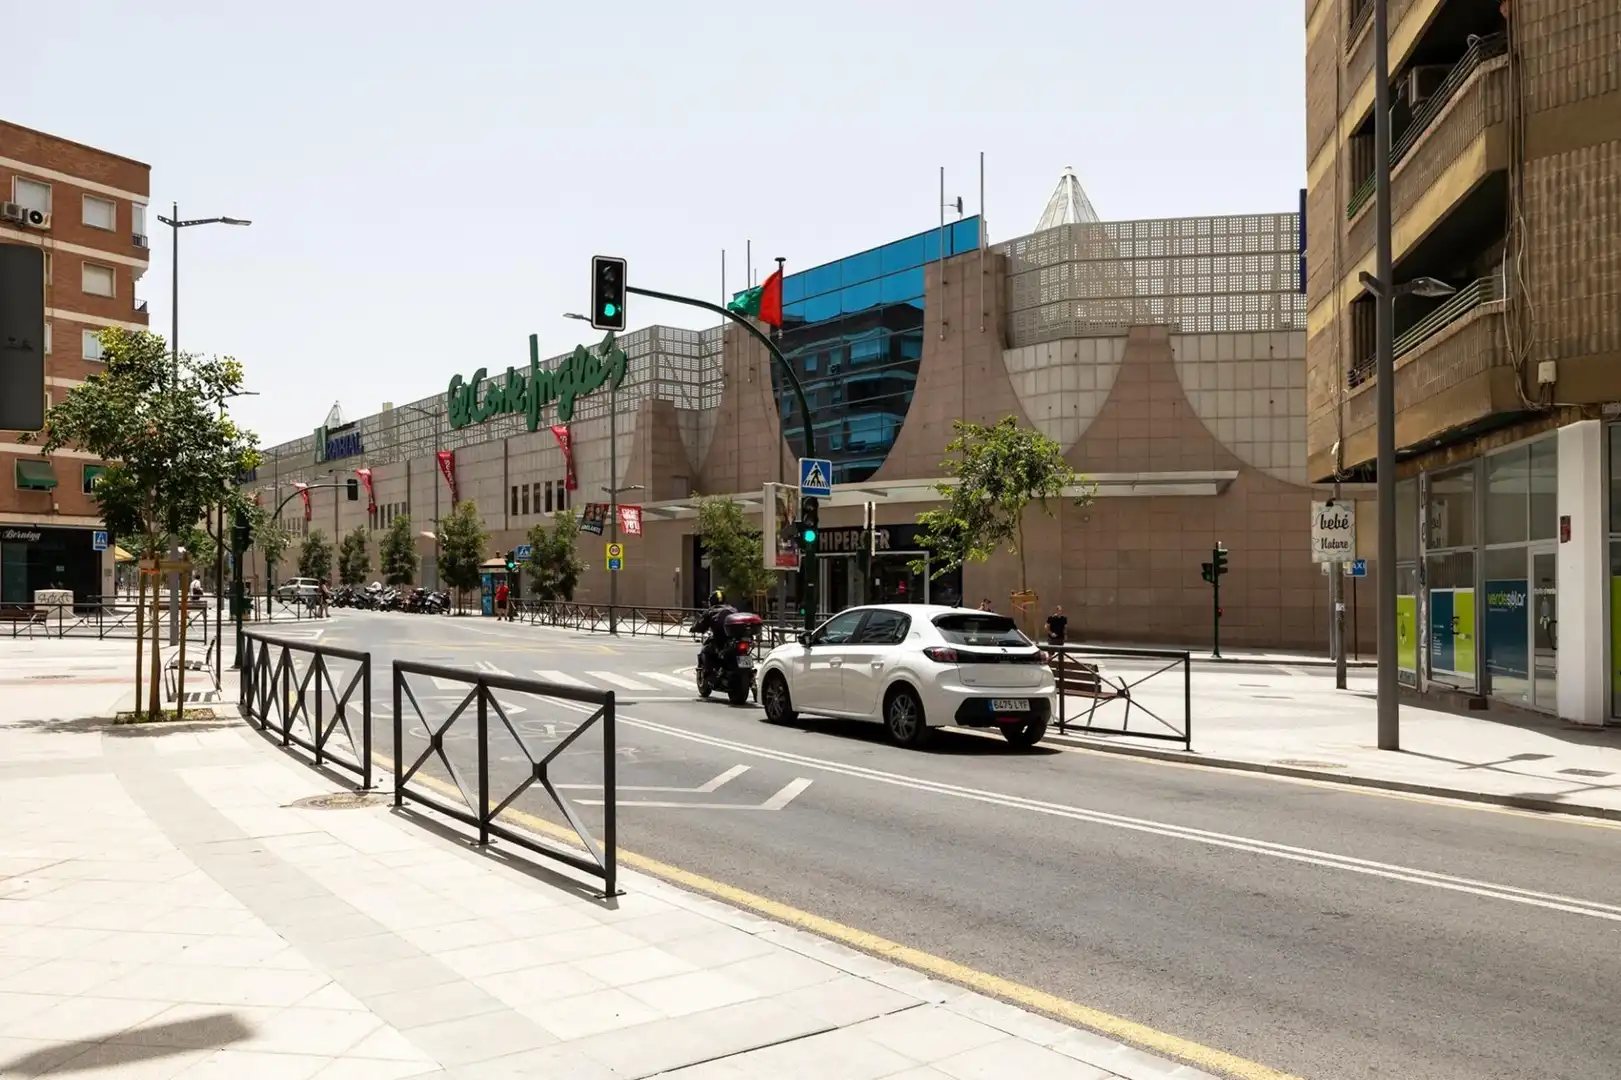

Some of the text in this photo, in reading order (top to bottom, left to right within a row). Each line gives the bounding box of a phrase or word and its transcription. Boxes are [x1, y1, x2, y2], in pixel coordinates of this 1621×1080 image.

[1320, 513, 1350, 530] bebé
[819, 529, 891, 551] HIPERCR
[994, 700, 1013, 710] 6475
